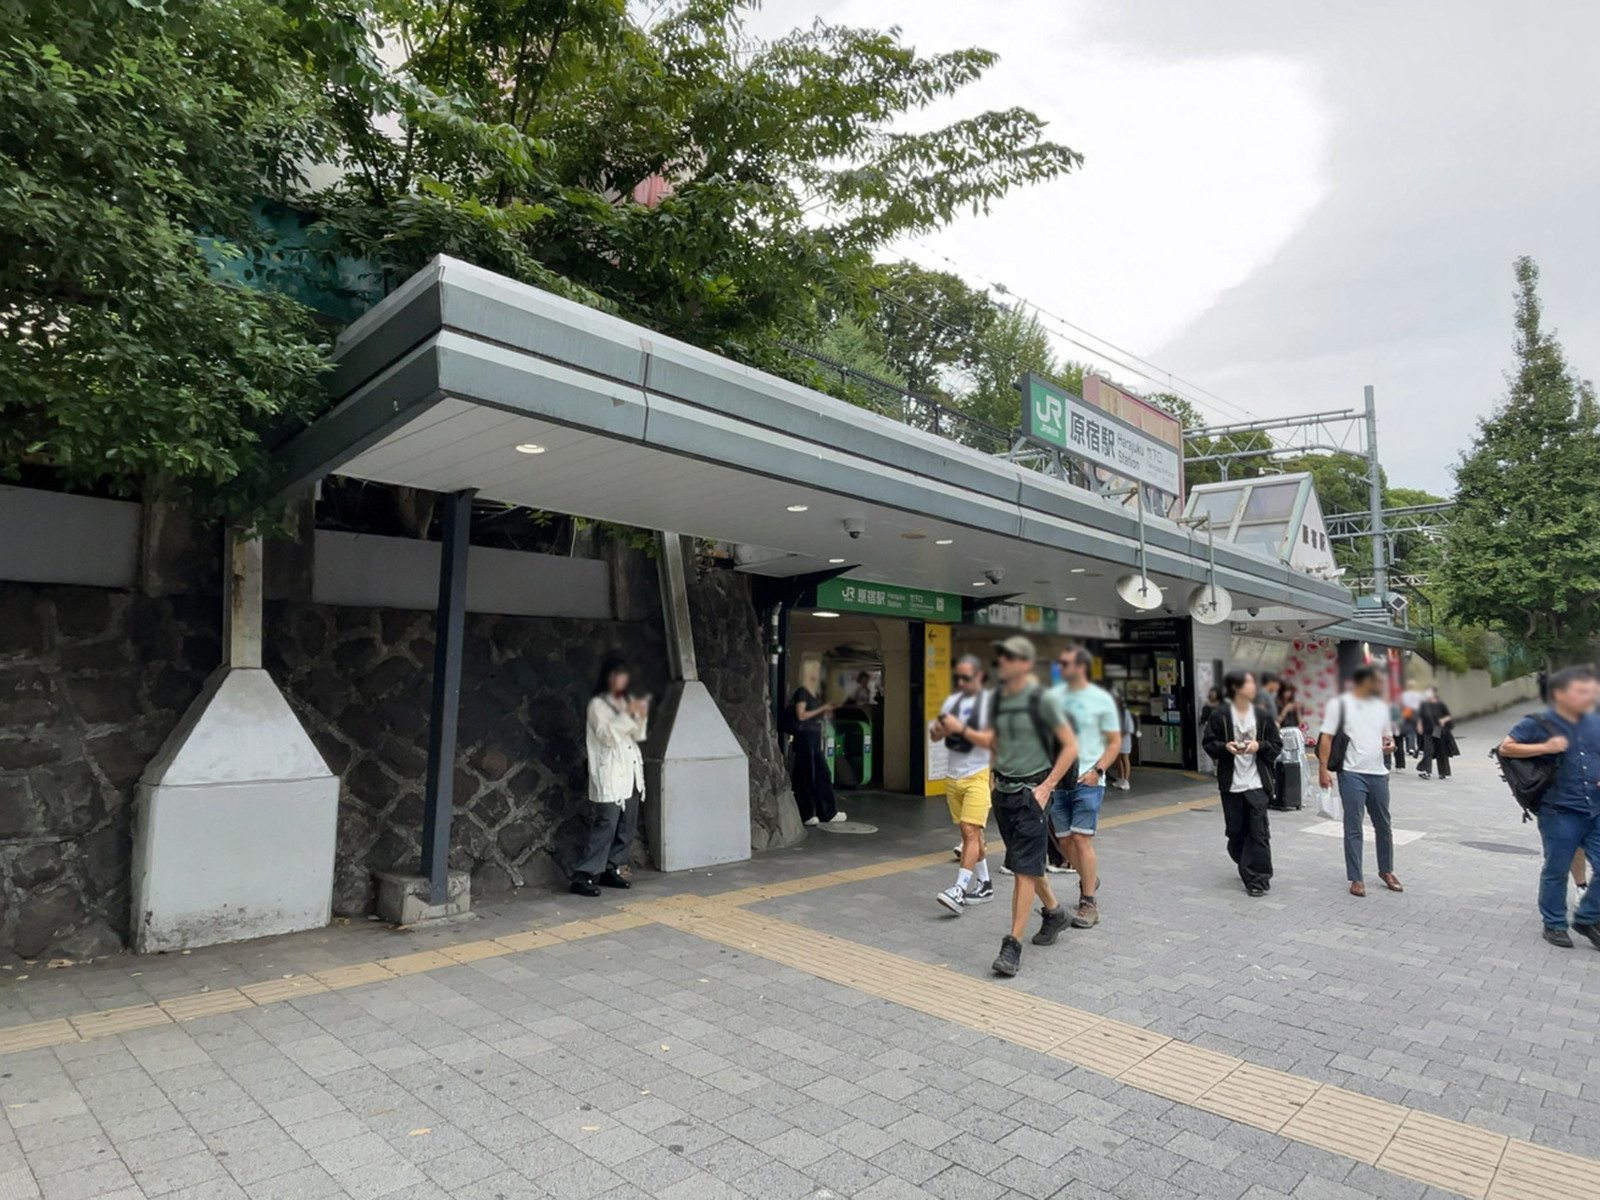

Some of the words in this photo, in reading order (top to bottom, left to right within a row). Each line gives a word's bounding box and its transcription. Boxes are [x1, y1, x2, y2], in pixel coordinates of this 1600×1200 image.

[1036, 395, 1062, 430] JR
[1070, 411, 1116, 459] 原宿駅
[1118, 450, 1140, 471] Station
[841, 586, 855, 598] JR
